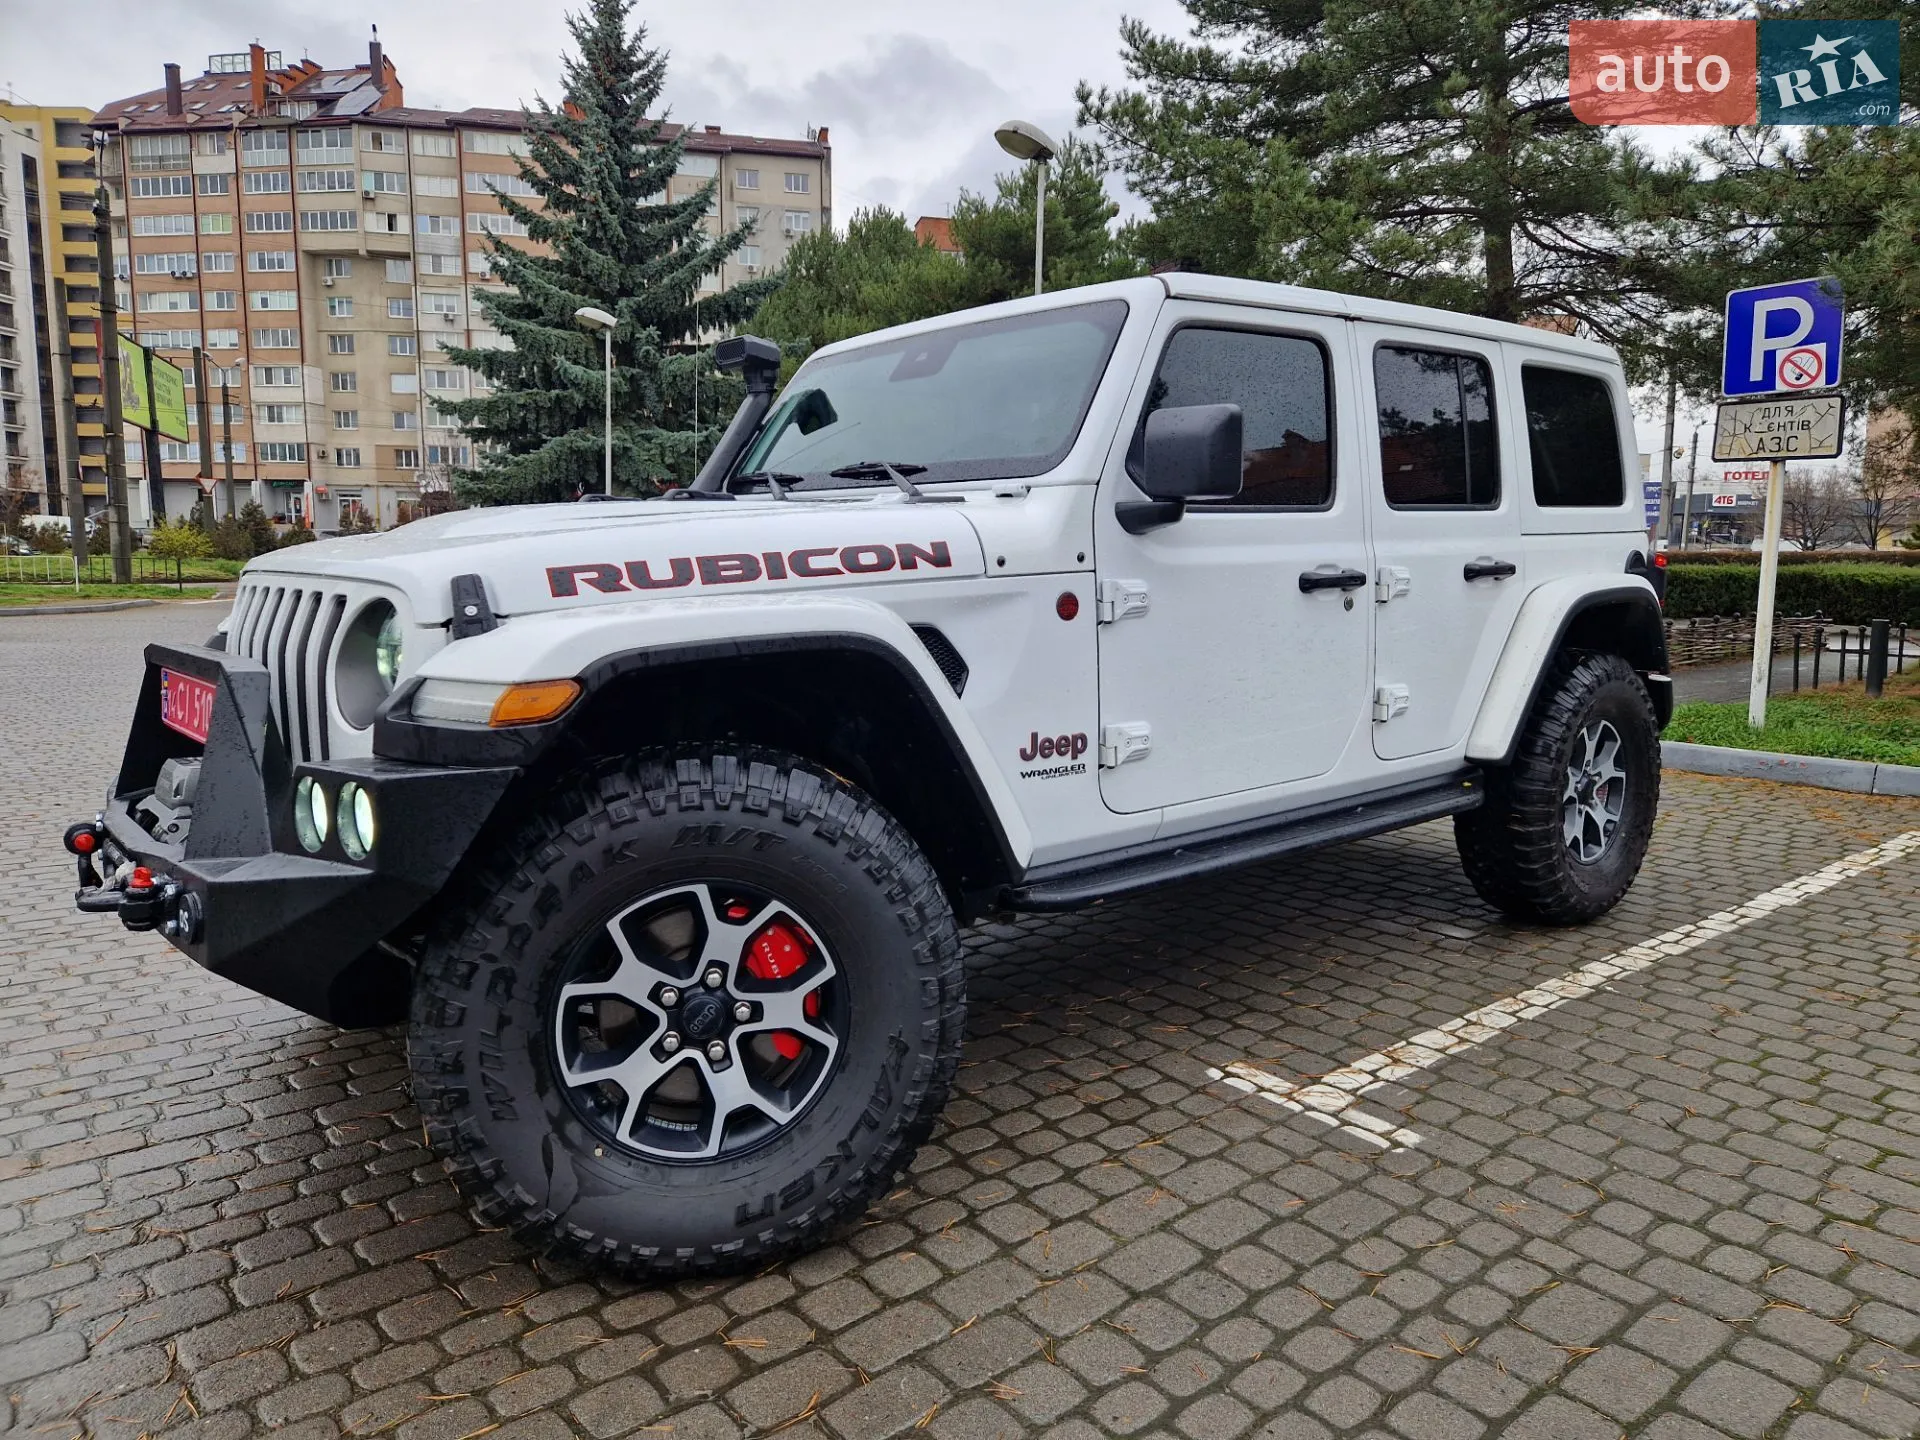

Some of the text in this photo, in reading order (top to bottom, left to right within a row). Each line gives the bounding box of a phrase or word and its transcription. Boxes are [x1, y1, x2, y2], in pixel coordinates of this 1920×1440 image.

[1749, 296, 1815, 382] P
[1761, 405, 1794, 420] ДЛЯ
[1744, 420, 1811, 434] КЄНТІВ
[1756, 436, 1799, 453] АЗС
[1714, 496, 1735, 505] АТБ
[545, 541, 953, 598] RUBICON
[1019, 731, 1088, 761] Jeep
[1020, 763, 1086, 779] WRANGLER
